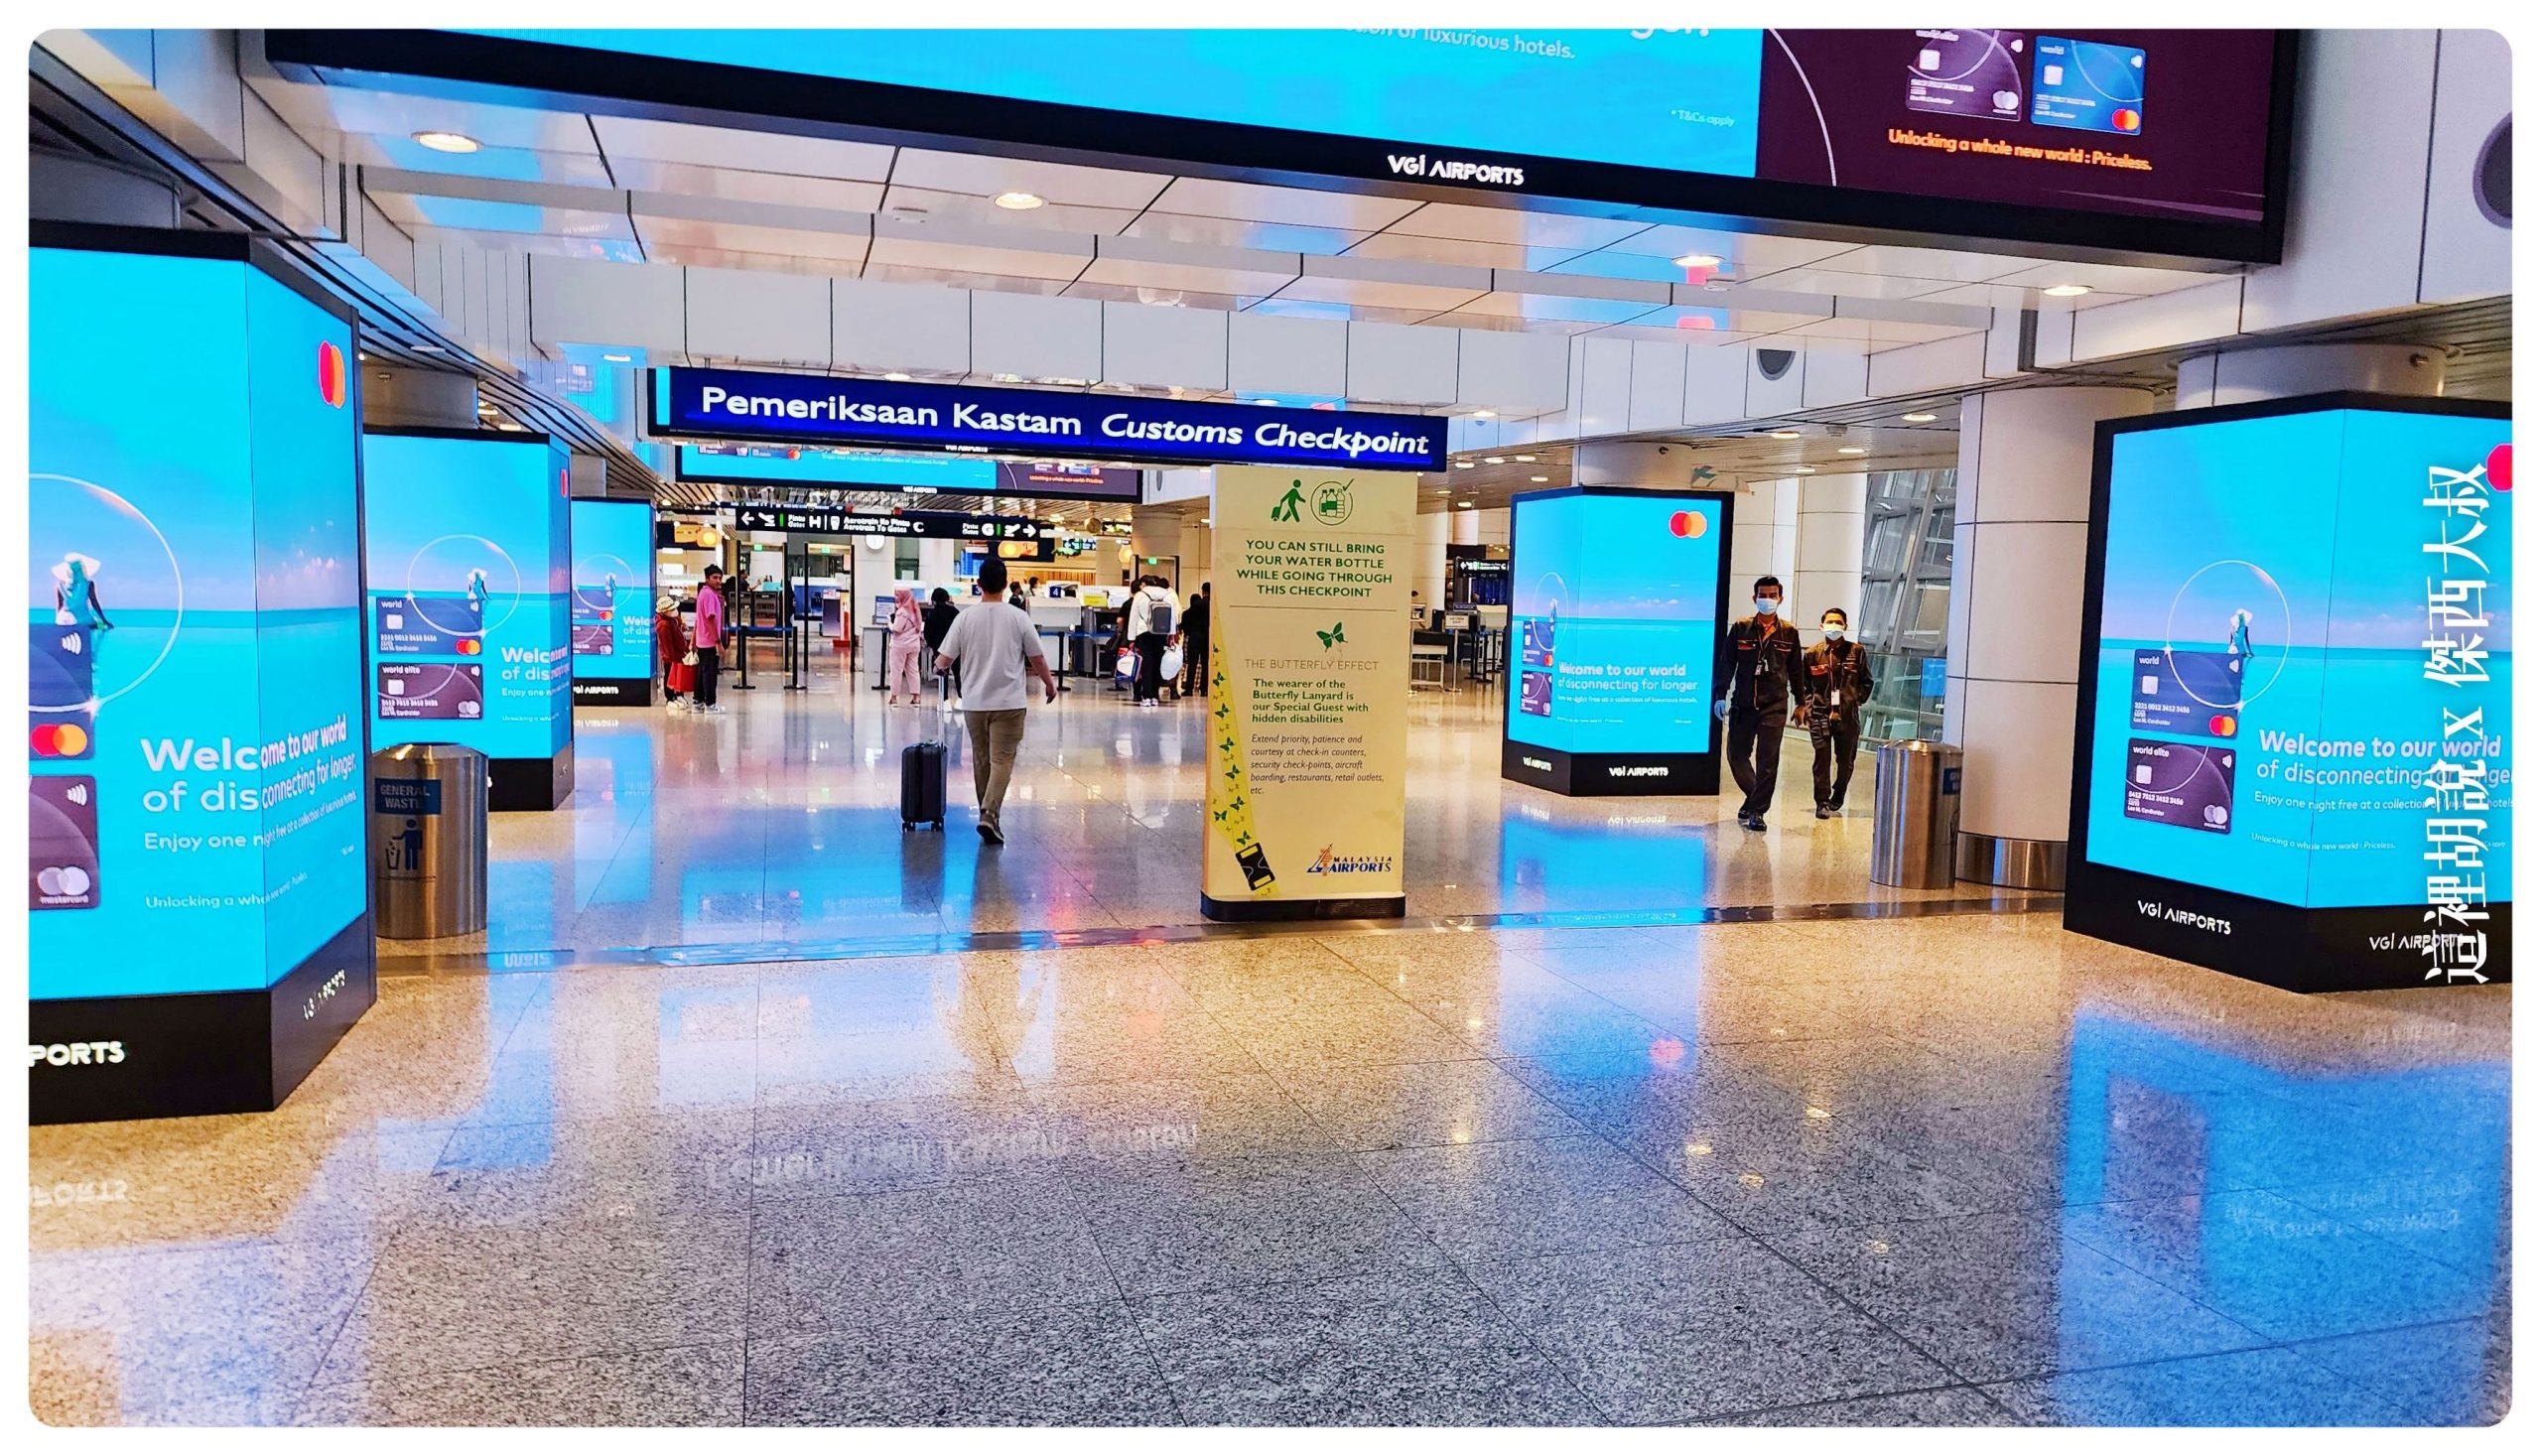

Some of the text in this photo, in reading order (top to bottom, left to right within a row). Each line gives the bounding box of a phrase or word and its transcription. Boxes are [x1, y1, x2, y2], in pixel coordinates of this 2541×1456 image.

[1422, 29, 1510, 51] luxurious
[1514, 34, 1576, 60] hotels.
[1888, 128, 2153, 171] Unlocking a whole new world Priceless.
[1428, 160, 1525, 186] AIRPORTS
[702, 385, 1429, 458] Pemeriksaan Kastam Customs Checkpoint
[809, 515, 822, 529] H
[912, 521, 925, 533] C
[981, 522, 995, 536] G
[1246, 539, 1385, 554] YOU CAN STILL BRING
[1246, 554, 1384, 569] YOUR WATER BOTTLE
[1237, 569, 1393, 584] WHILE GOING THROUGH
[1052, 588, 1060, 596] 4
[1257, 585, 1372, 597] THIS CHECKPOINT
[1245, 659, 1380, 671] THE BUTTERFLY EFFECT
[2139, 656, 2160, 665] world
[501, 665, 521, 681] of
[1558, 660, 1686, 676] Welcome to our world
[1253, 678, 1346, 689] The wearer of the
[1642, 678, 1660, 690] for
[1661, 678, 1699, 693] longer.
[1253, 690, 1354, 702] Butterfly Lanyard is
[1273, 703, 1310, 713] Special
[1313, 703, 1344, 712] Guest
[1346, 704, 1369, 713] with
[1252, 714, 1344, 724] hidden disabilities
[141, 713, 347, 772] Welcome to our world
[1251, 733, 1363, 744] Extend priority, patience and
[2259, 728, 2501, 758] Welcome to our world
[1251, 748, 1284, 758] courtesy
[1296, 747, 1329, 756] check-in
[1331, 748, 1367, 757] counters,
[2133, 745, 2170, 757] world elite
[1250, 760, 1363, 770] security check-points, aircraft
[1626, 766, 1670, 777] AIRPORTS
[1250, 773, 1286, 783] boarding,
[1335, 773, 1355, 782] retail
[1357, 773, 1385, 783] outlets,
[2256, 758, 2280, 779] of
[2284, 761, 2423, 790] disconnecting
[143, 752, 357, 812] of disconnecting for longer.
[380, 784, 431, 796] GENERAL
[1250, 786, 1266, 795] etc.
[2254, 790, 2284, 807] Enjoy
[2286, 798, 2306, 809] one
[2308, 799, 2336, 812] night
[2338, 799, 2358, 810] free
[2360, 800, 2372, 810] at
[2373, 801, 2381, 810] a
[144, 832, 202, 854] Enjoy
[207, 834, 247, 849] one
[2251, 832, 2288, 848] Unlocking
[2296, 841, 2321, 851] whole
[2338, 842, 2358, 851] world
[1329, 861, 1392, 873] AIRPORTS
[146, 895, 235, 909] Unlocking a
[2164, 907, 2231, 935] AIRPORTS
